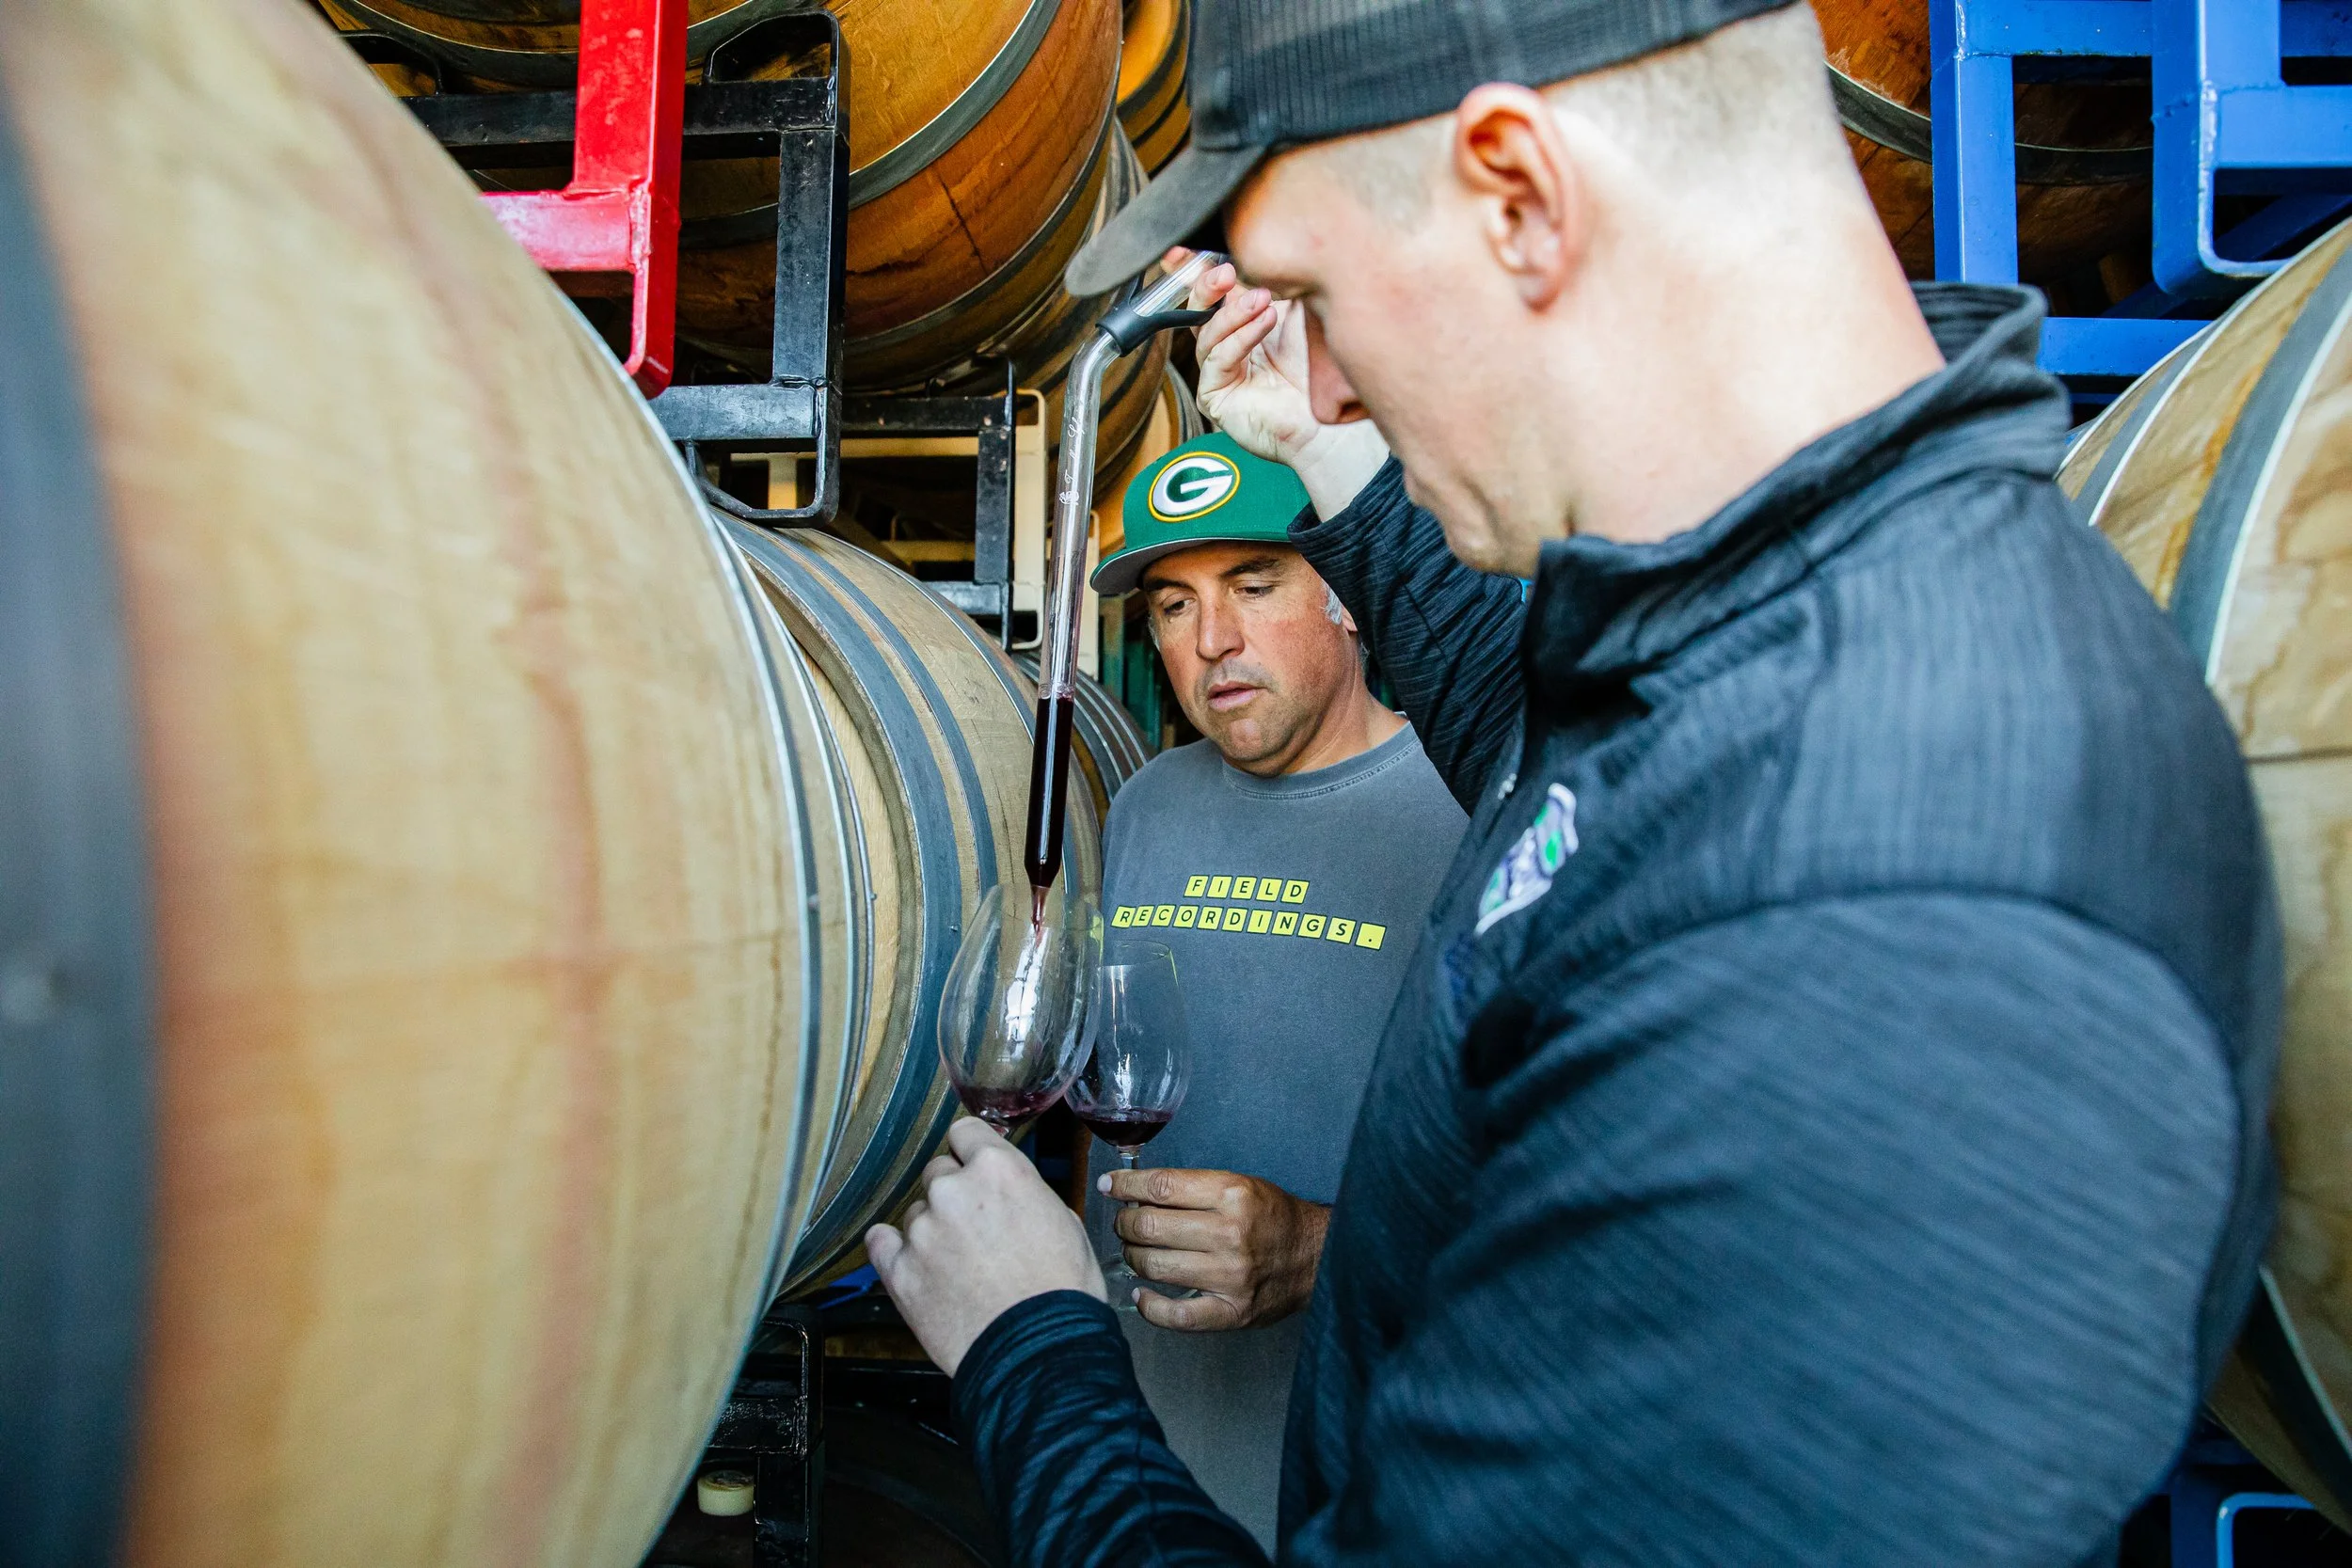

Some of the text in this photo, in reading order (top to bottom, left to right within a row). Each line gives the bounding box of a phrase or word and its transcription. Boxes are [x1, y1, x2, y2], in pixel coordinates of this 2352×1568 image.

[1152, 457, 1232, 515] G
[1190, 878, 1304, 899] FIELD
[1119, 909, 1374, 943] RECORDINGS.
